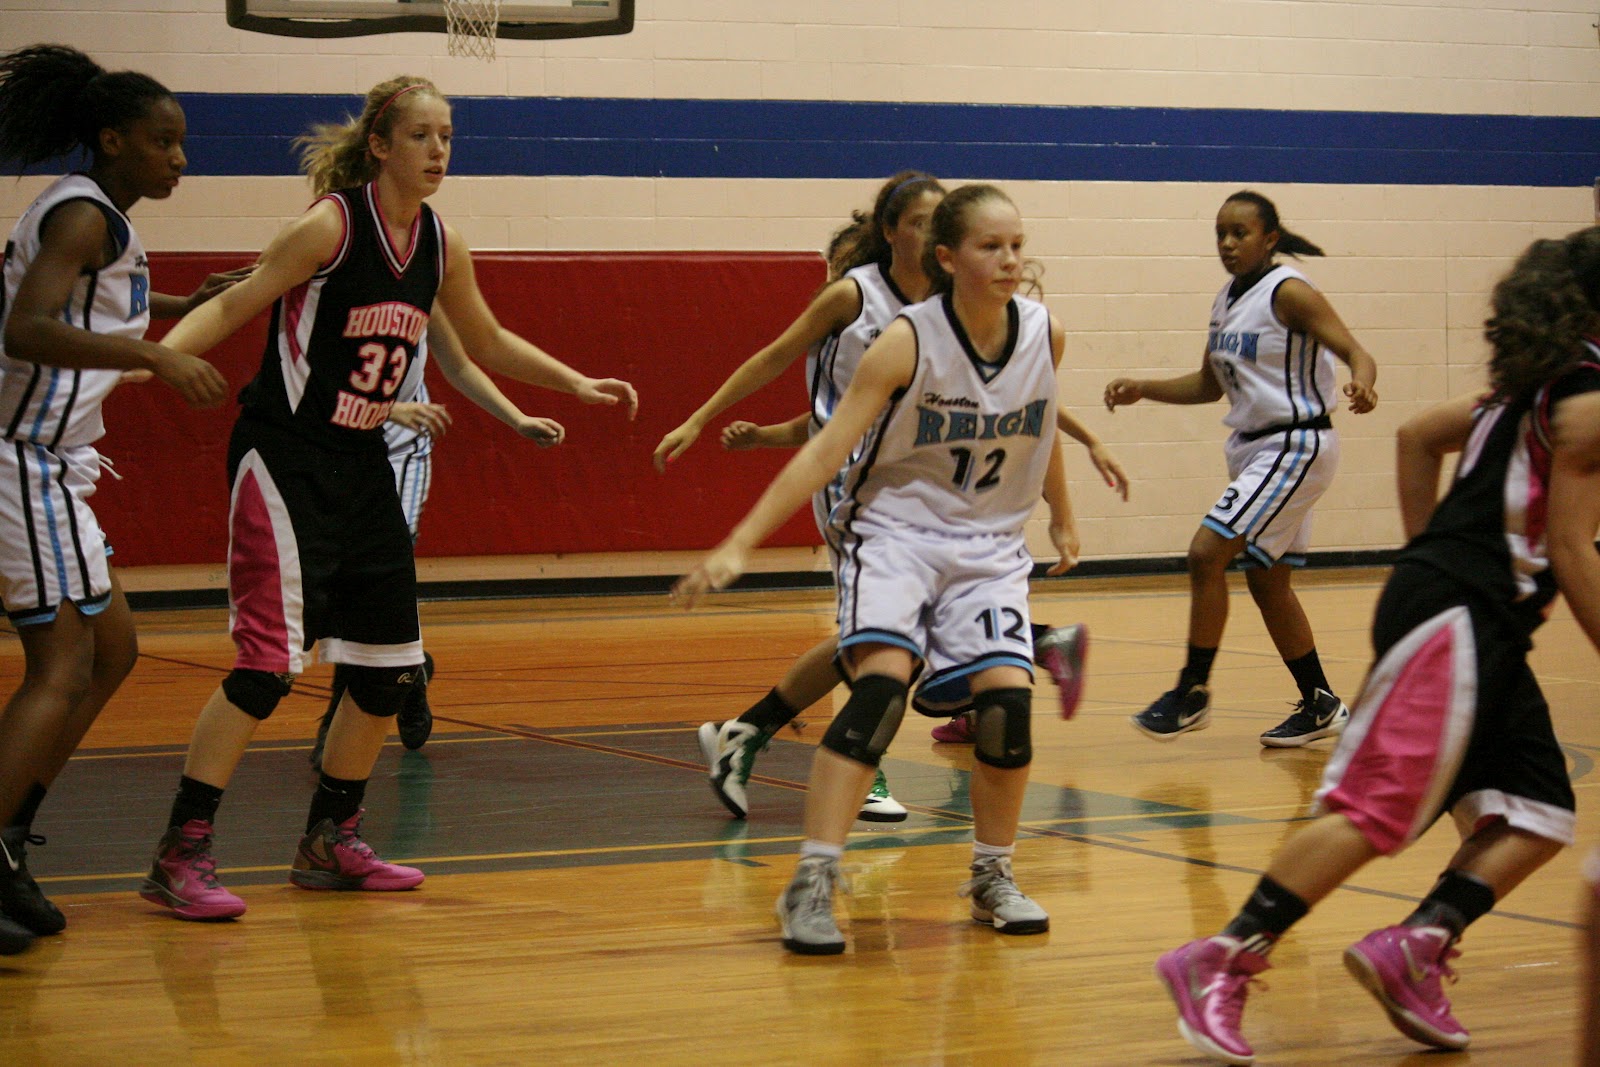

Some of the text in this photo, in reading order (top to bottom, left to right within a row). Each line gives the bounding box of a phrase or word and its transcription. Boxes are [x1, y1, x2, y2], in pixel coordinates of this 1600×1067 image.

[350, 342, 407, 396] 33
[914, 399, 1048, 447] REIGN
[924, 393, 980, 409] Houston
[950, 447, 1006, 493] 12
[974, 606, 1028, 645] 12
